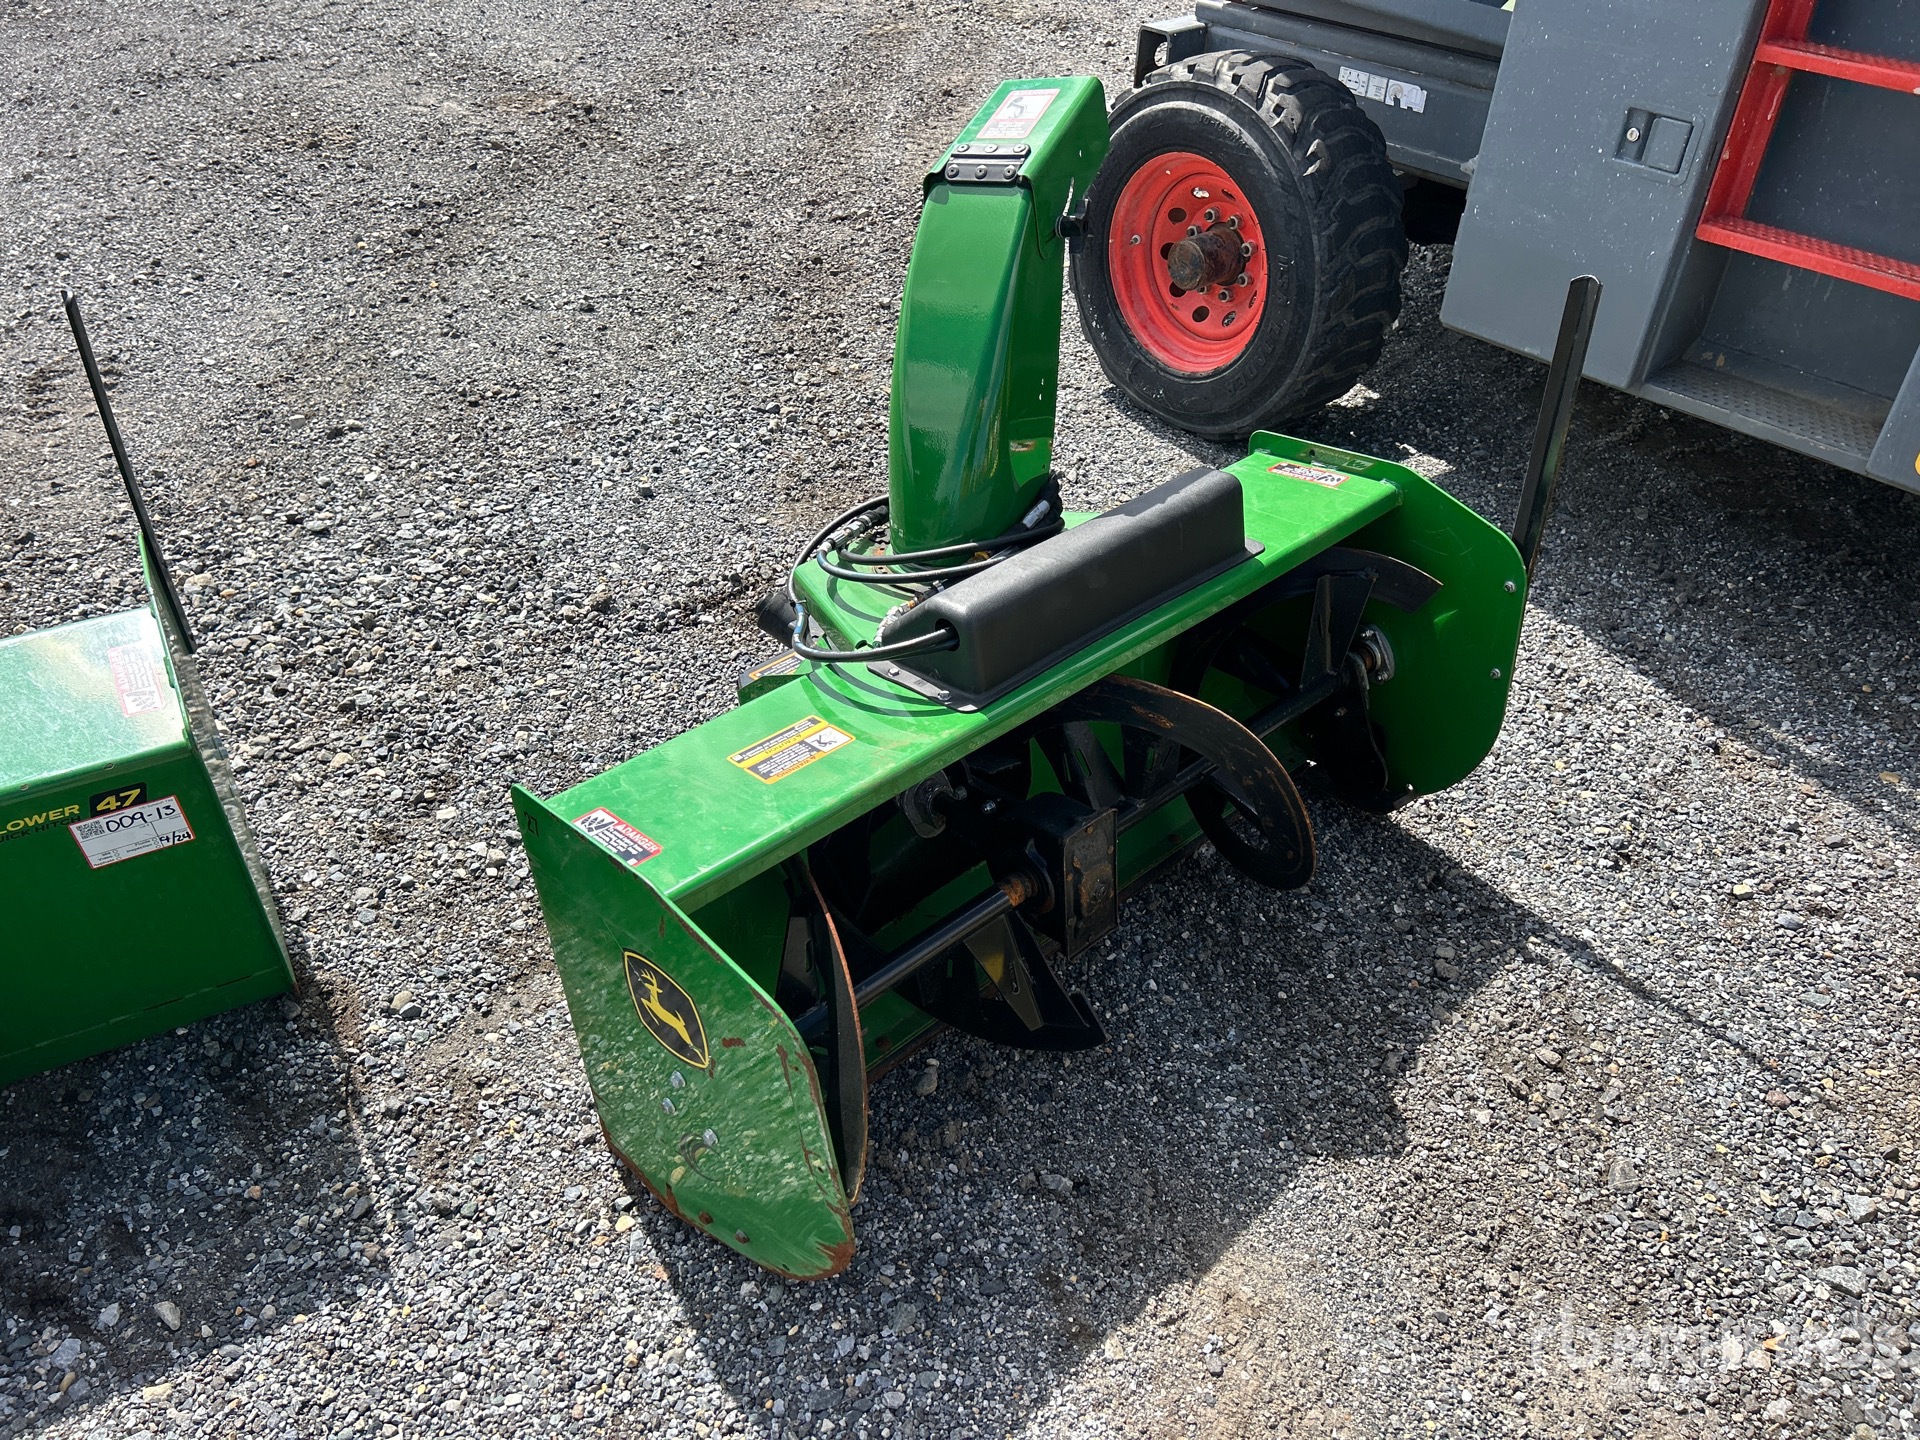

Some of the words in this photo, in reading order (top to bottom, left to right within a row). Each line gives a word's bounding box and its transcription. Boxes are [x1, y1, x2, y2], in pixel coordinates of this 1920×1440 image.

[96, 788, 141, 812] 47
[34, 816, 81, 833] HITCH
[622, 826, 659, 853] DANGER
